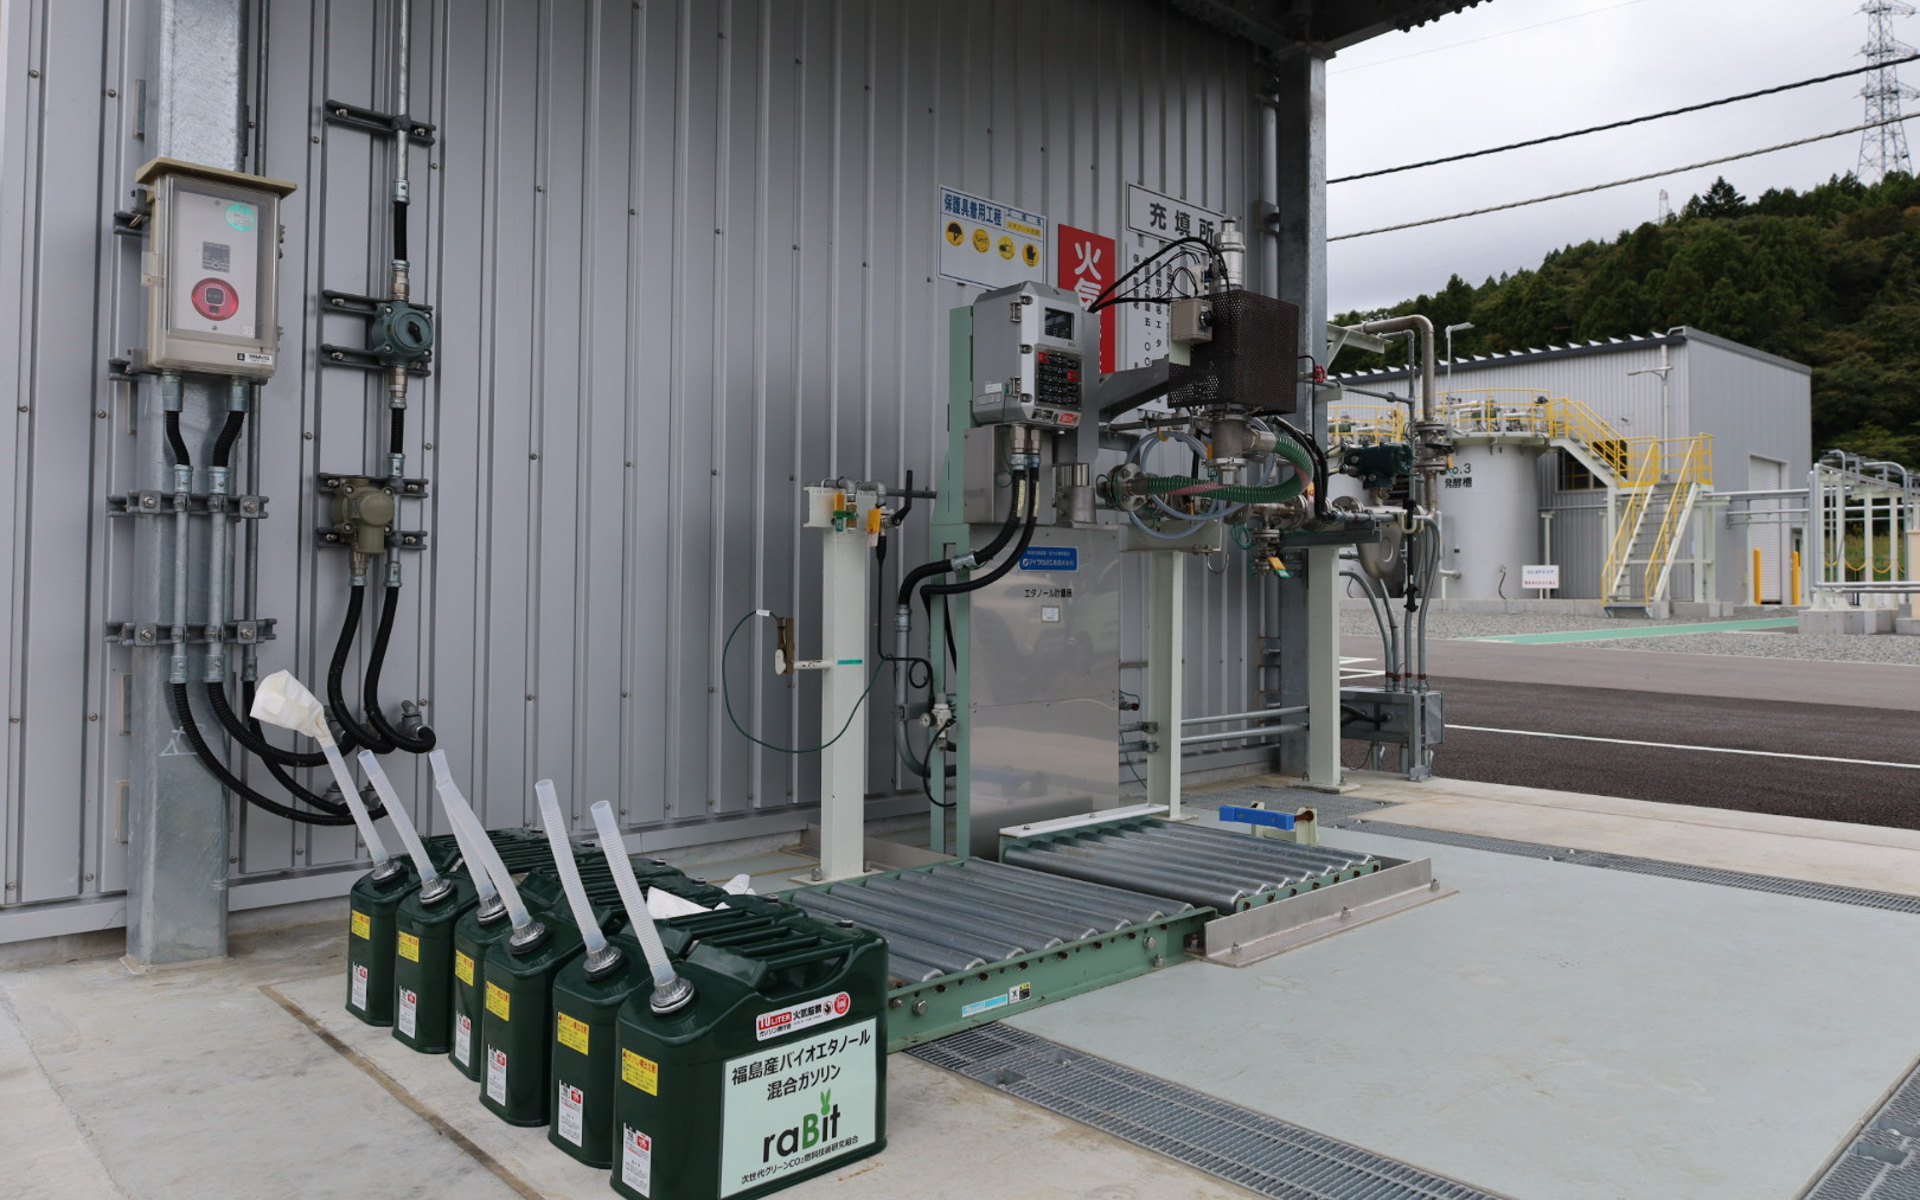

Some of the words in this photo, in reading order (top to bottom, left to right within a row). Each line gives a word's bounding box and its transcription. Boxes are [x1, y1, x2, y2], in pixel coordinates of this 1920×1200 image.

[1447, 463, 1471, 474] o.3
[732, 1029, 870, 1085] 福島産バイオエタノール
[767, 1064, 841, 1100] 混合ガソリン
[763, 1102, 841, 1163] raBit
